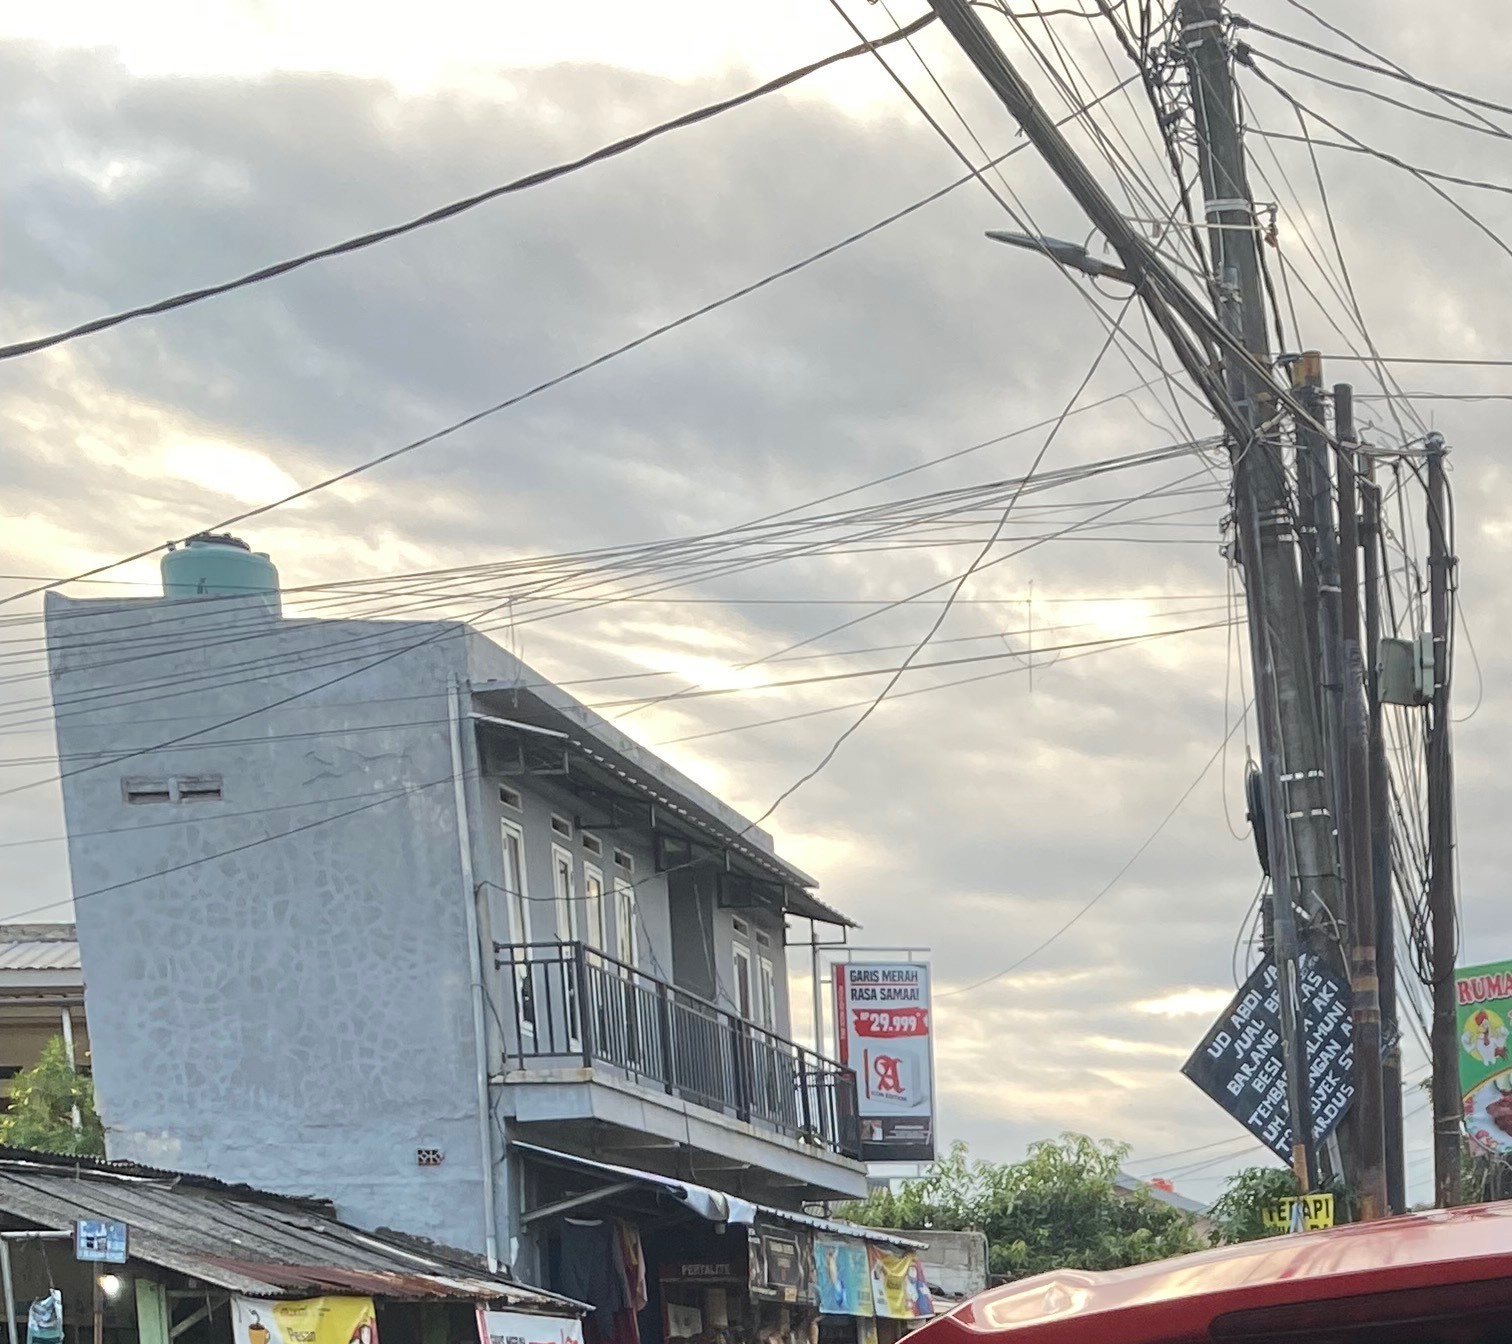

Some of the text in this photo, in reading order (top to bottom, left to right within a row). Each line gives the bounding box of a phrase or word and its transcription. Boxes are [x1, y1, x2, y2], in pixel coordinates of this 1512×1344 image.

[850, 970, 918, 982] GARIS MERAH
[851, 988, 877, 1000] RASA
[1207, 1030, 1232, 1059] UD
[1230, 989, 1263, 1031] ABDI
[1235, 1019, 1265, 1059] JUAL
[1251, 981, 1338, 1094] BESI AKI
[1226, 1029, 1279, 1096] BARANG
[1263, 1118, 1286, 1143] UM
